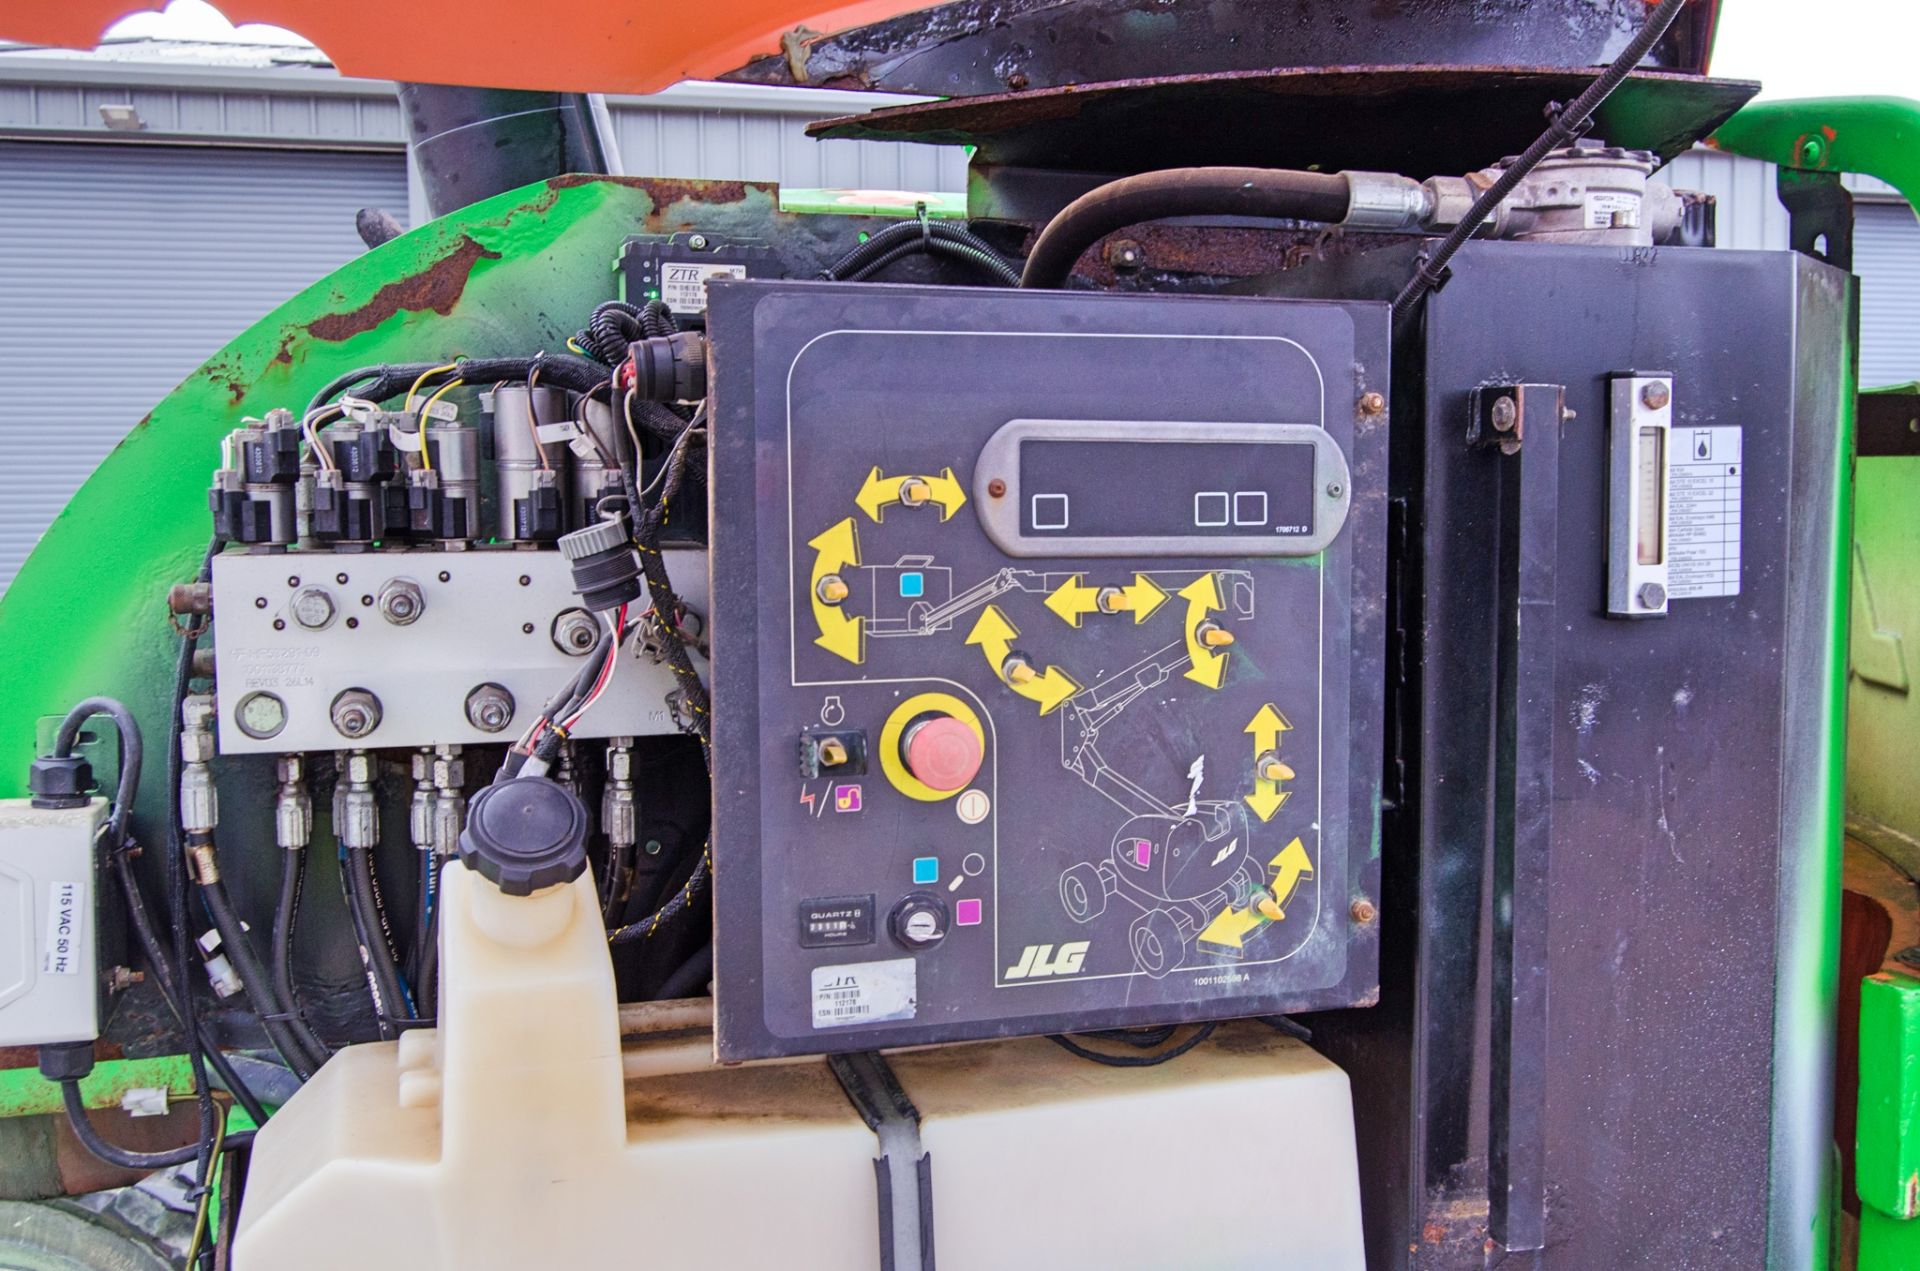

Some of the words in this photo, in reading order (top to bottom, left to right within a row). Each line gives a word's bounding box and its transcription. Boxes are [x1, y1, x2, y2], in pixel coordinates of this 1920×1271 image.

[669, 268, 699, 280] ZTR
[1211, 837, 1238, 867] JLG
[60, 884, 73, 906] 115
[58, 909, 72, 935] VAC
[811, 911, 852, 919] QUARTZ
[56, 938, 70, 954] 50
[55, 957, 69, 973] Hz
[1004, 941, 1090, 979] JLG
[1242, 973, 1250, 982] A
